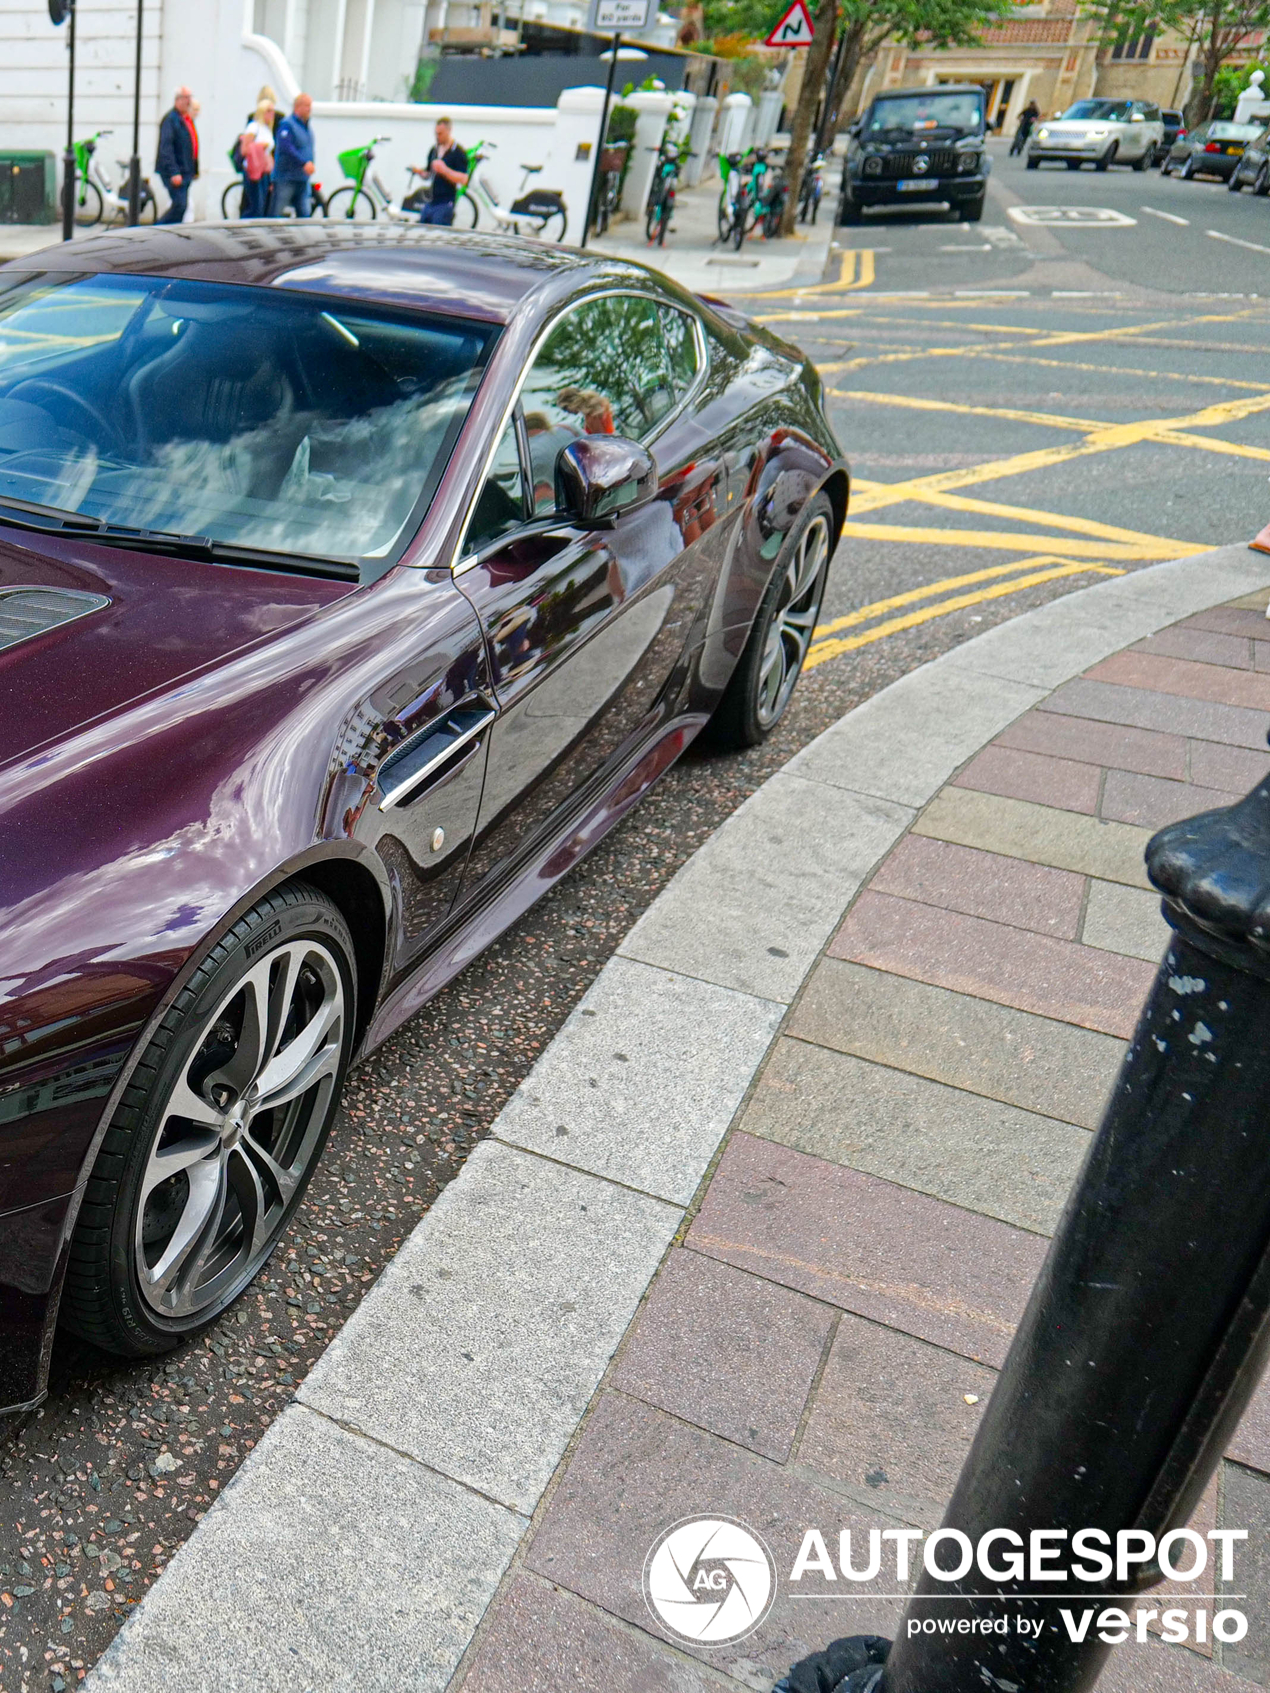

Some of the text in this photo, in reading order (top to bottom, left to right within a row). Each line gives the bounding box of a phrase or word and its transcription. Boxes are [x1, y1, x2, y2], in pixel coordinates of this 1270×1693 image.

[615, 3, 631, 11] For
[617, 13, 642, 22] yards
[243, 918, 282, 959] PIRELLI
